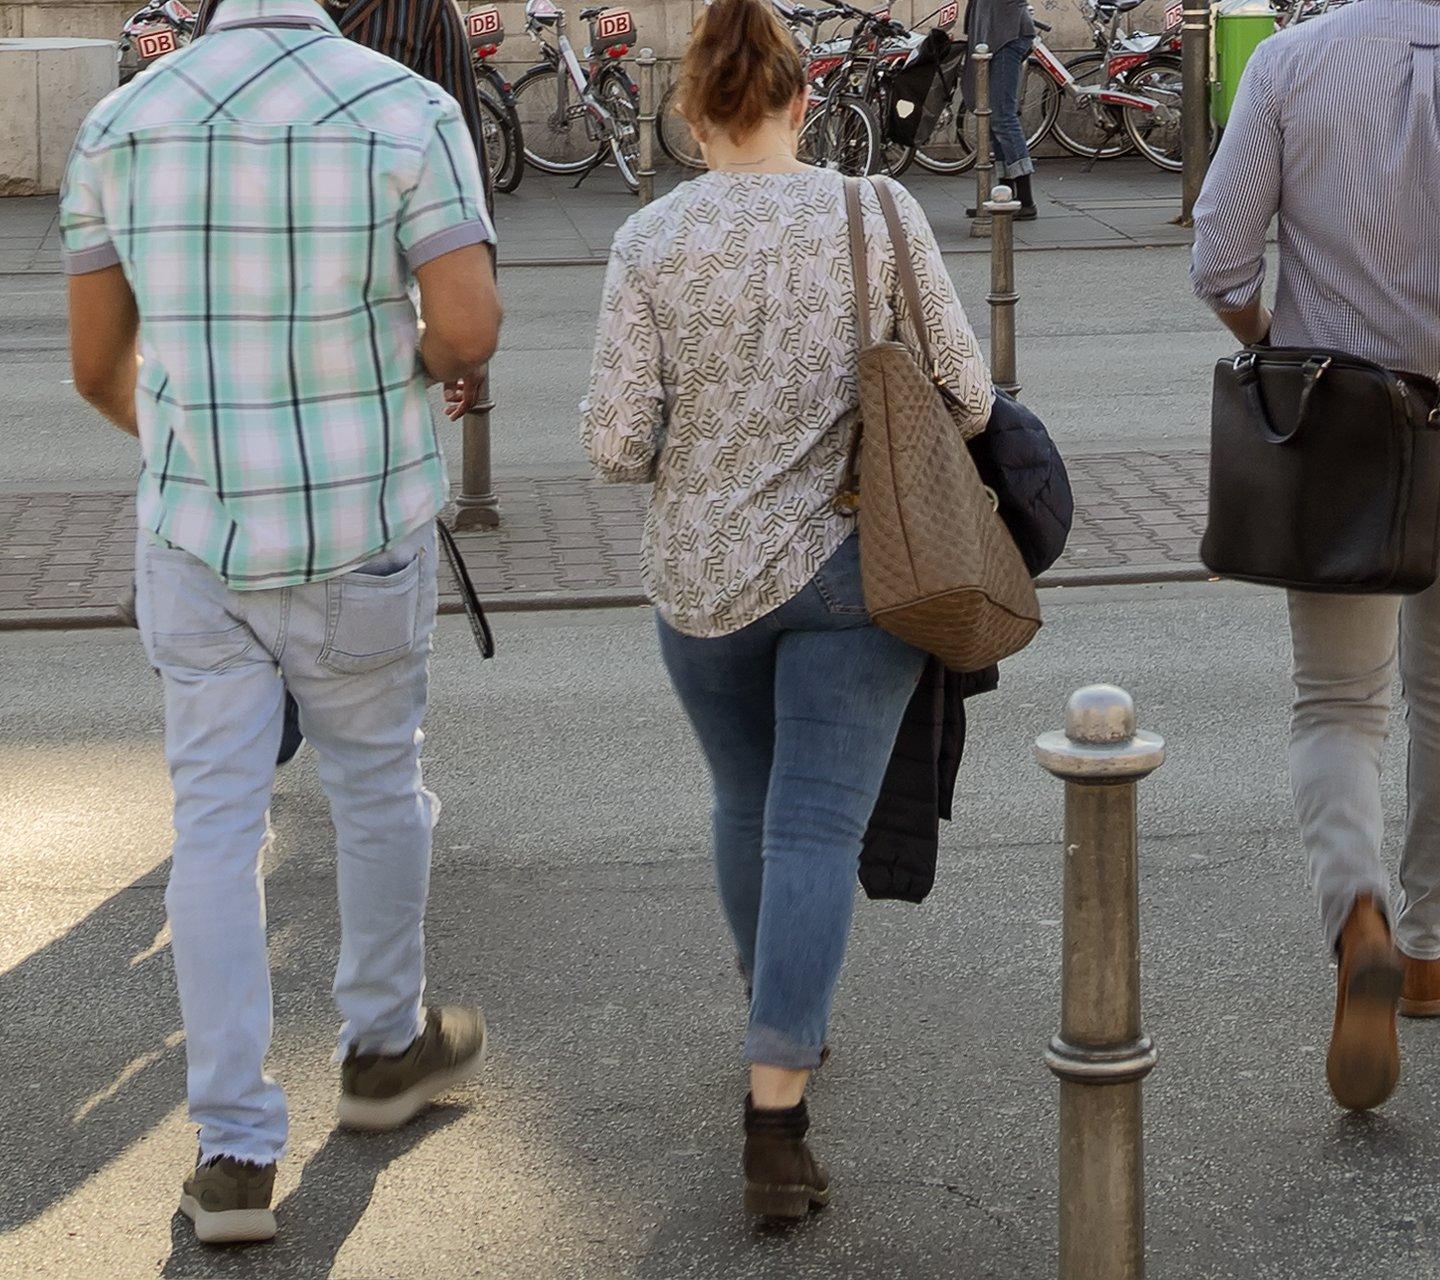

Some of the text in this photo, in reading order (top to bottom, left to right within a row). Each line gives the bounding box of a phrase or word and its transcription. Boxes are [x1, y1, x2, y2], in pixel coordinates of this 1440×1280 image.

[473, 15, 495, 33] DB
[604, 16, 627, 35] DB
[143, 35, 171, 55] DB
